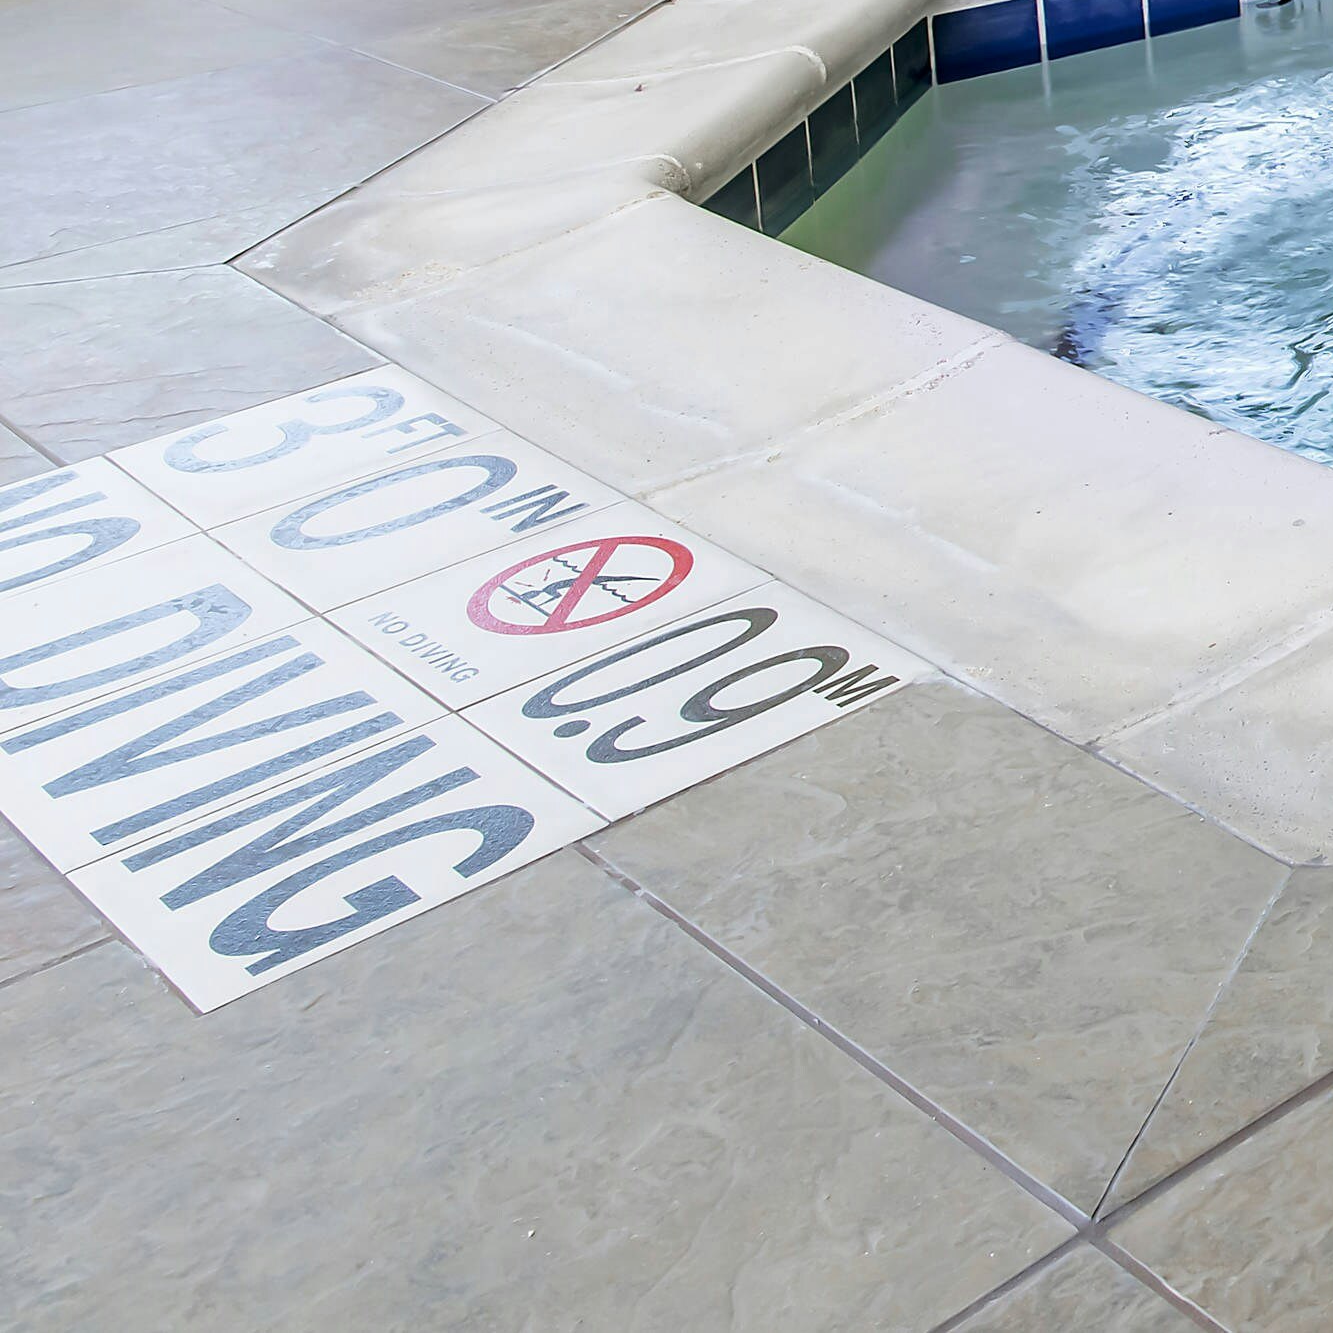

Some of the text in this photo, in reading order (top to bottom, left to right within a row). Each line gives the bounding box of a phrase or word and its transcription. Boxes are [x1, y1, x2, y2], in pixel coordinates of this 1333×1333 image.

[368, 612, 479, 683] NO DIVING
[0, 583, 535, 976] DIVING
